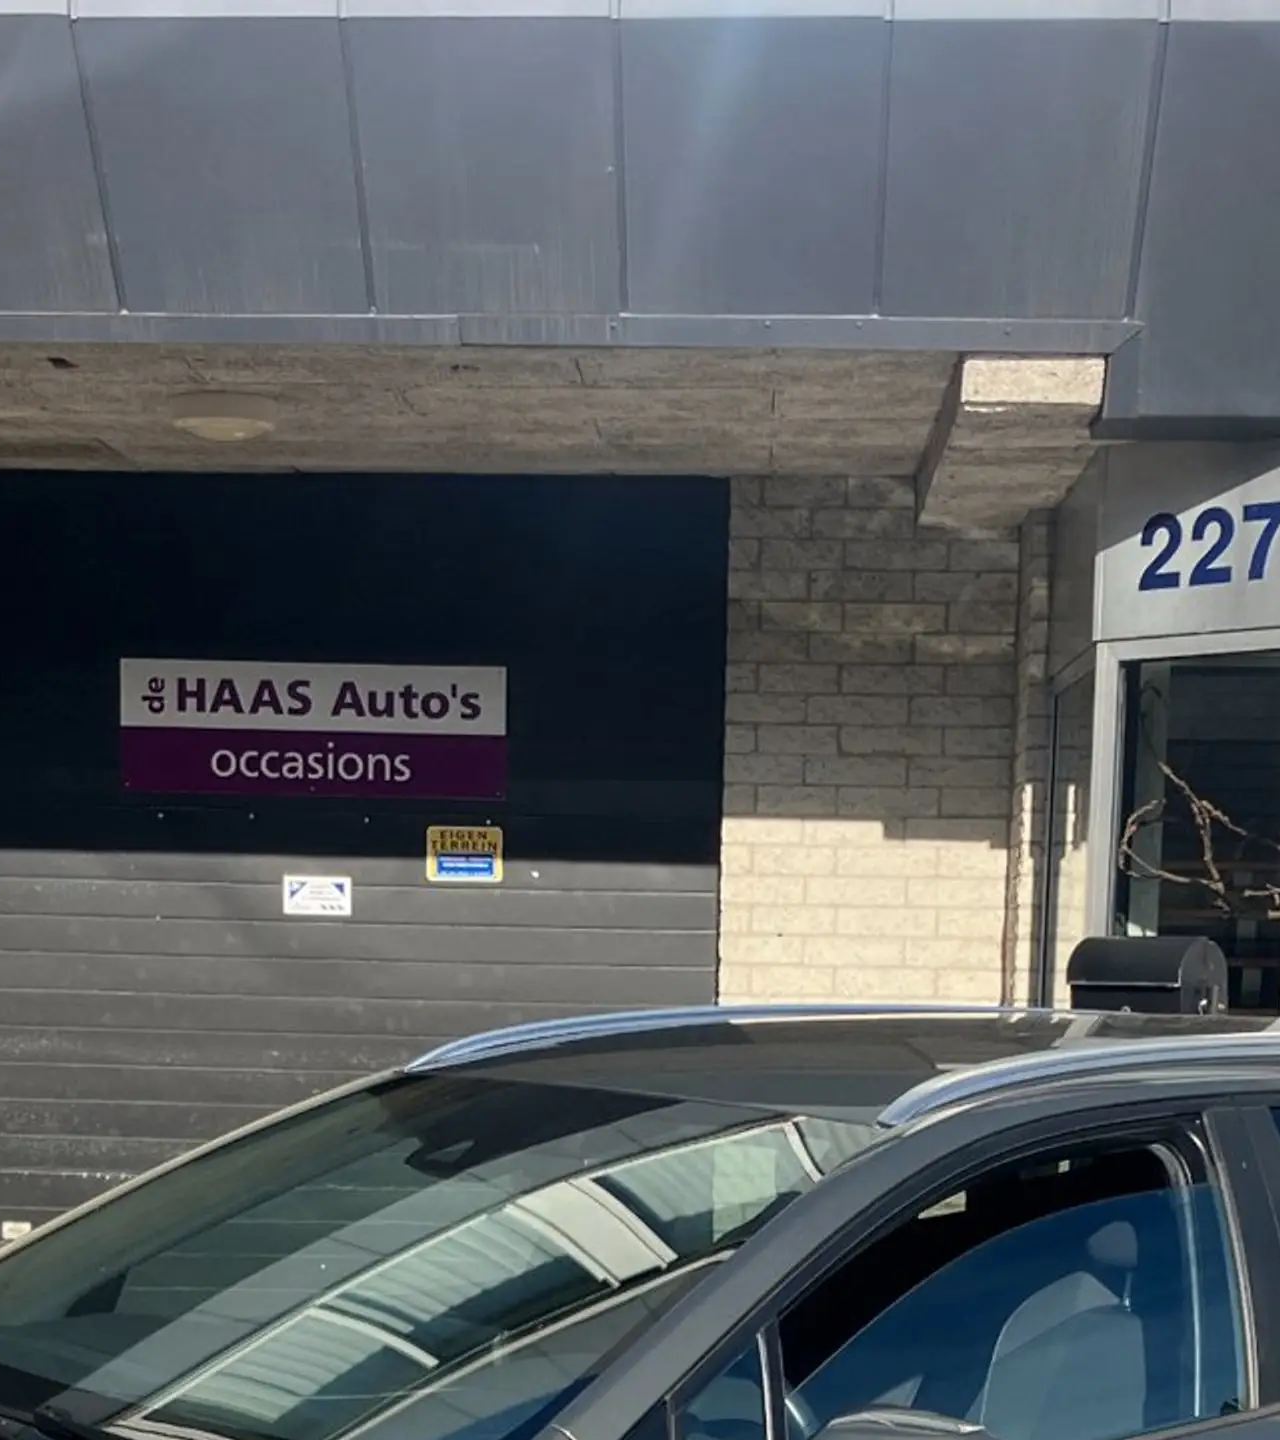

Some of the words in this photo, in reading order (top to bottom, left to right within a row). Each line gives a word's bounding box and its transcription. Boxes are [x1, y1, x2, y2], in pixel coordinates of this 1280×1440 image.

[141, 676, 165, 713] de
[177, 677, 312, 716] HAAS
[331, 681, 482, 721] Auto's
[211, 741, 412, 782] occasions
[431, 840, 497, 851] TERREIN
[439, 830, 488, 840] EIGEN
